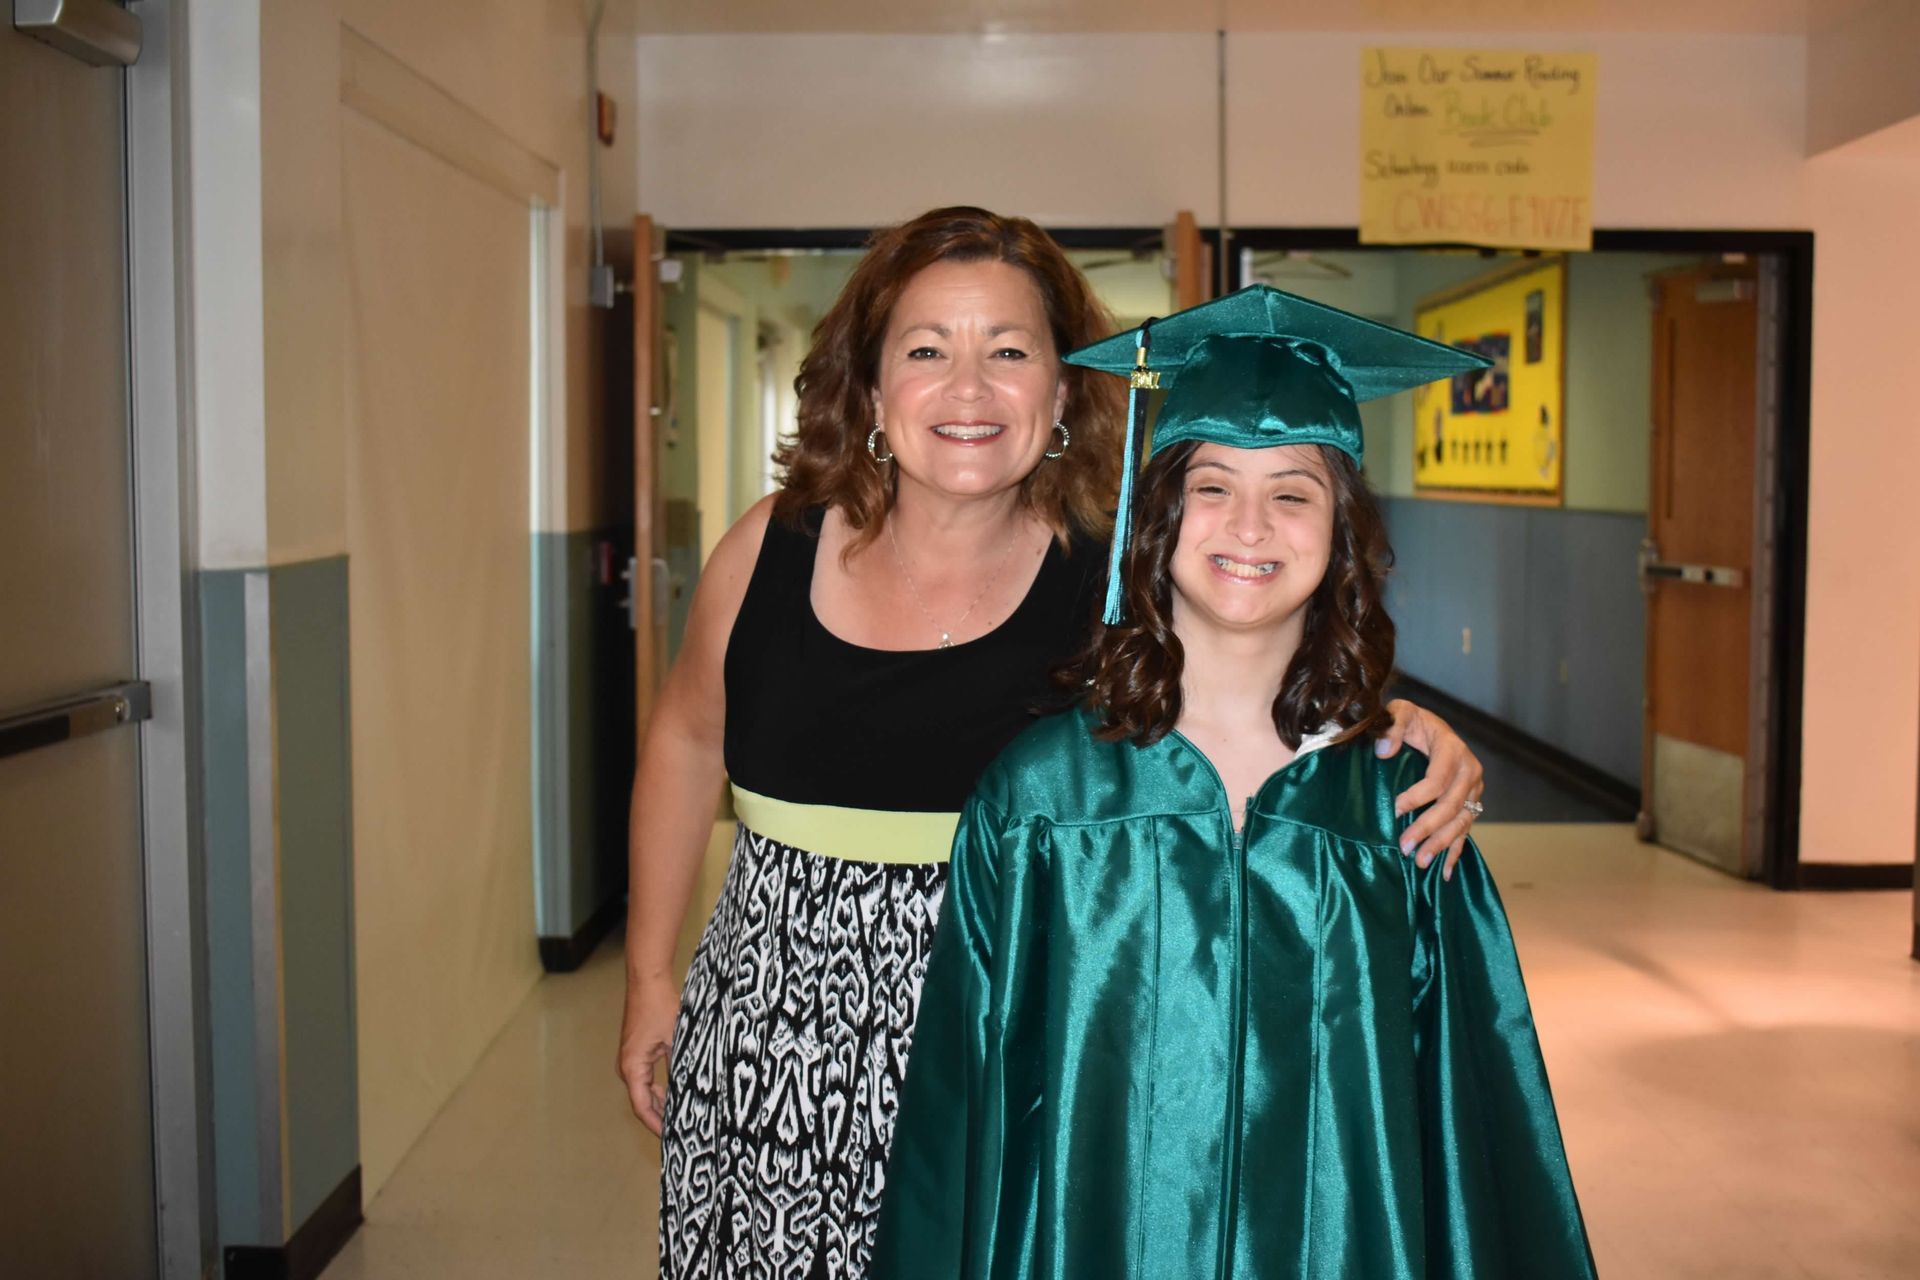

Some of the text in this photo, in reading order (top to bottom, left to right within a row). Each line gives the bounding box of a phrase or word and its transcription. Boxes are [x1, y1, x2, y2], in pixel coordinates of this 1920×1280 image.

[1365, 48, 1581, 95] Join Our Summer Reading
[1384, 87, 1553, 128] Online Book Club
[1130, 371, 1161, 389] 2017
